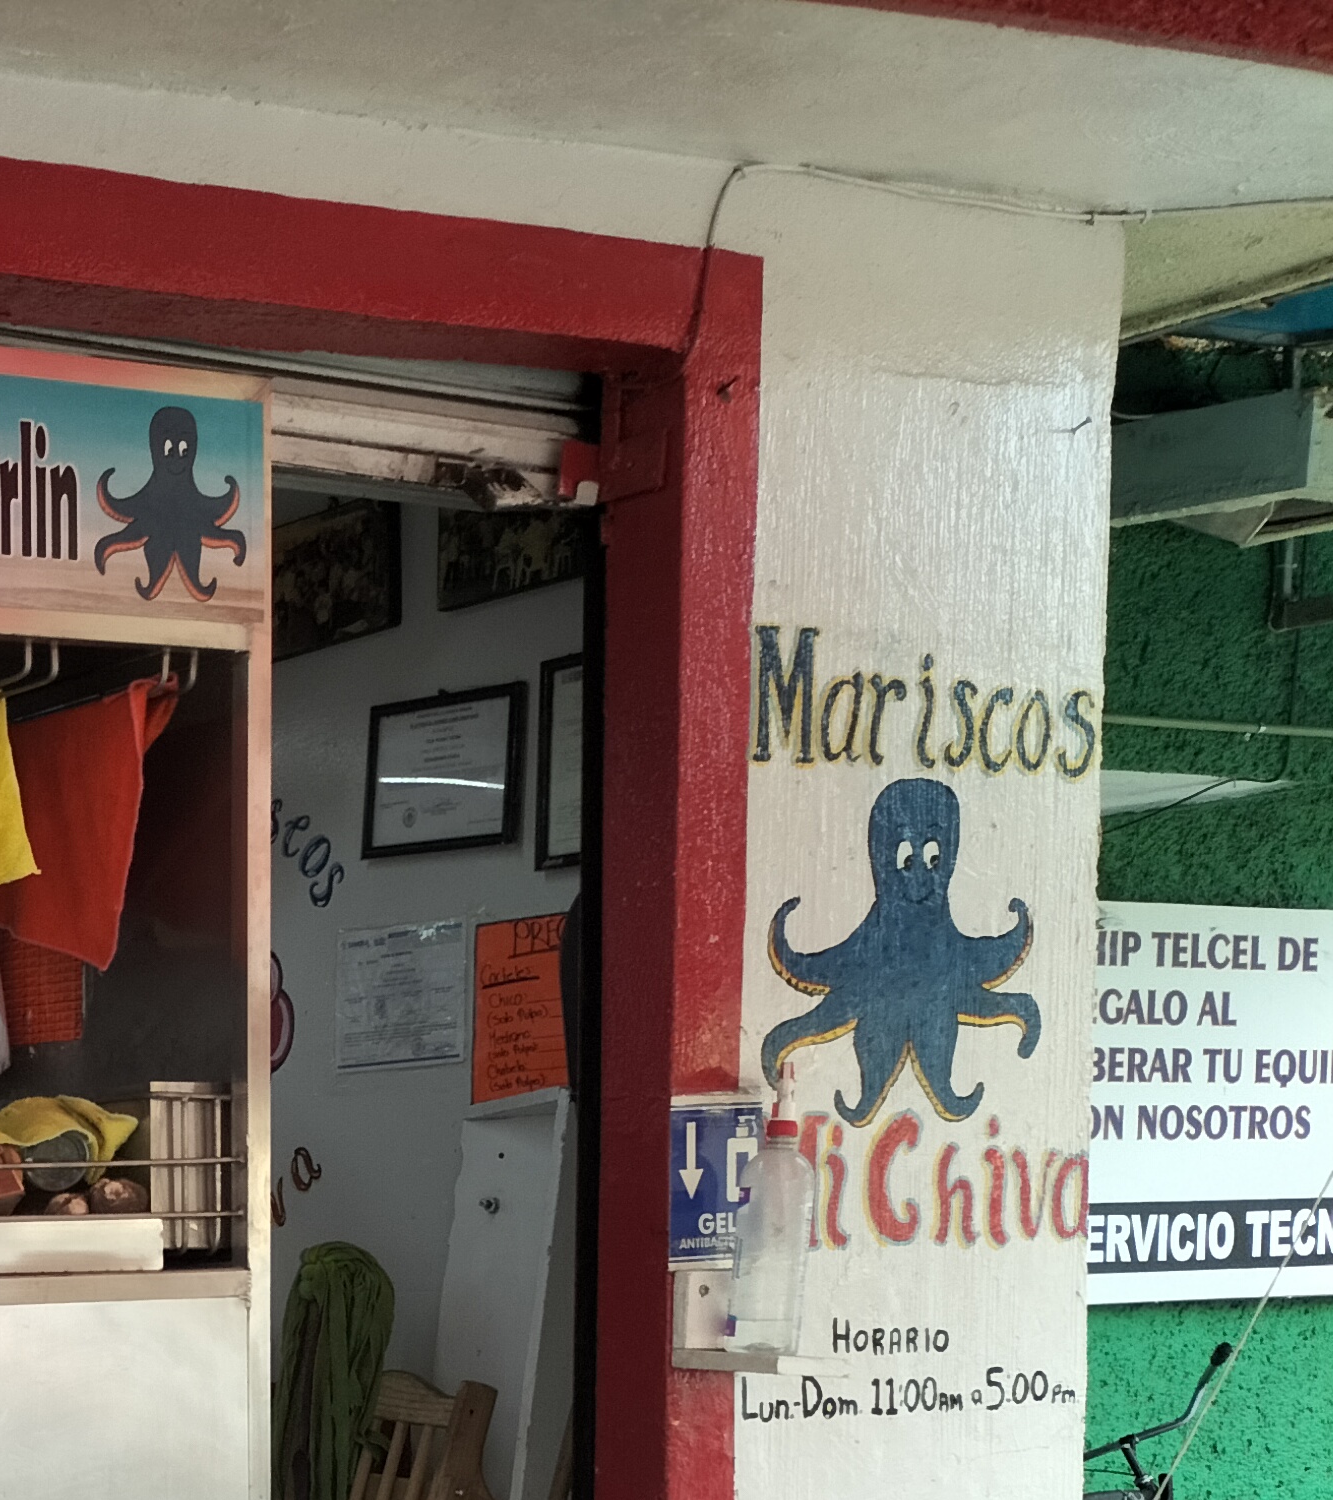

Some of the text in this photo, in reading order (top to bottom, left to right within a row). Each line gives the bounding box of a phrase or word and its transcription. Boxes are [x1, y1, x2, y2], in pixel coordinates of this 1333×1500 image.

[752, 625, 1096, 778] Mariscos
[1152, 932, 1266, 971] TELCEL
[1277, 937, 1319, 972] DE
[1197, 991, 1237, 1026] AL
[1203, 1048, 1243, 1083] TU
[1254, 1048, 1333, 1088] EQUI
[1137, 1105, 1311, 1141] NOSOTROS
[864, 1108, 1089, 1251] Chiva
[698, 1212, 736, 1234] GEL
[832, 1317, 950, 1355] HORARIO
